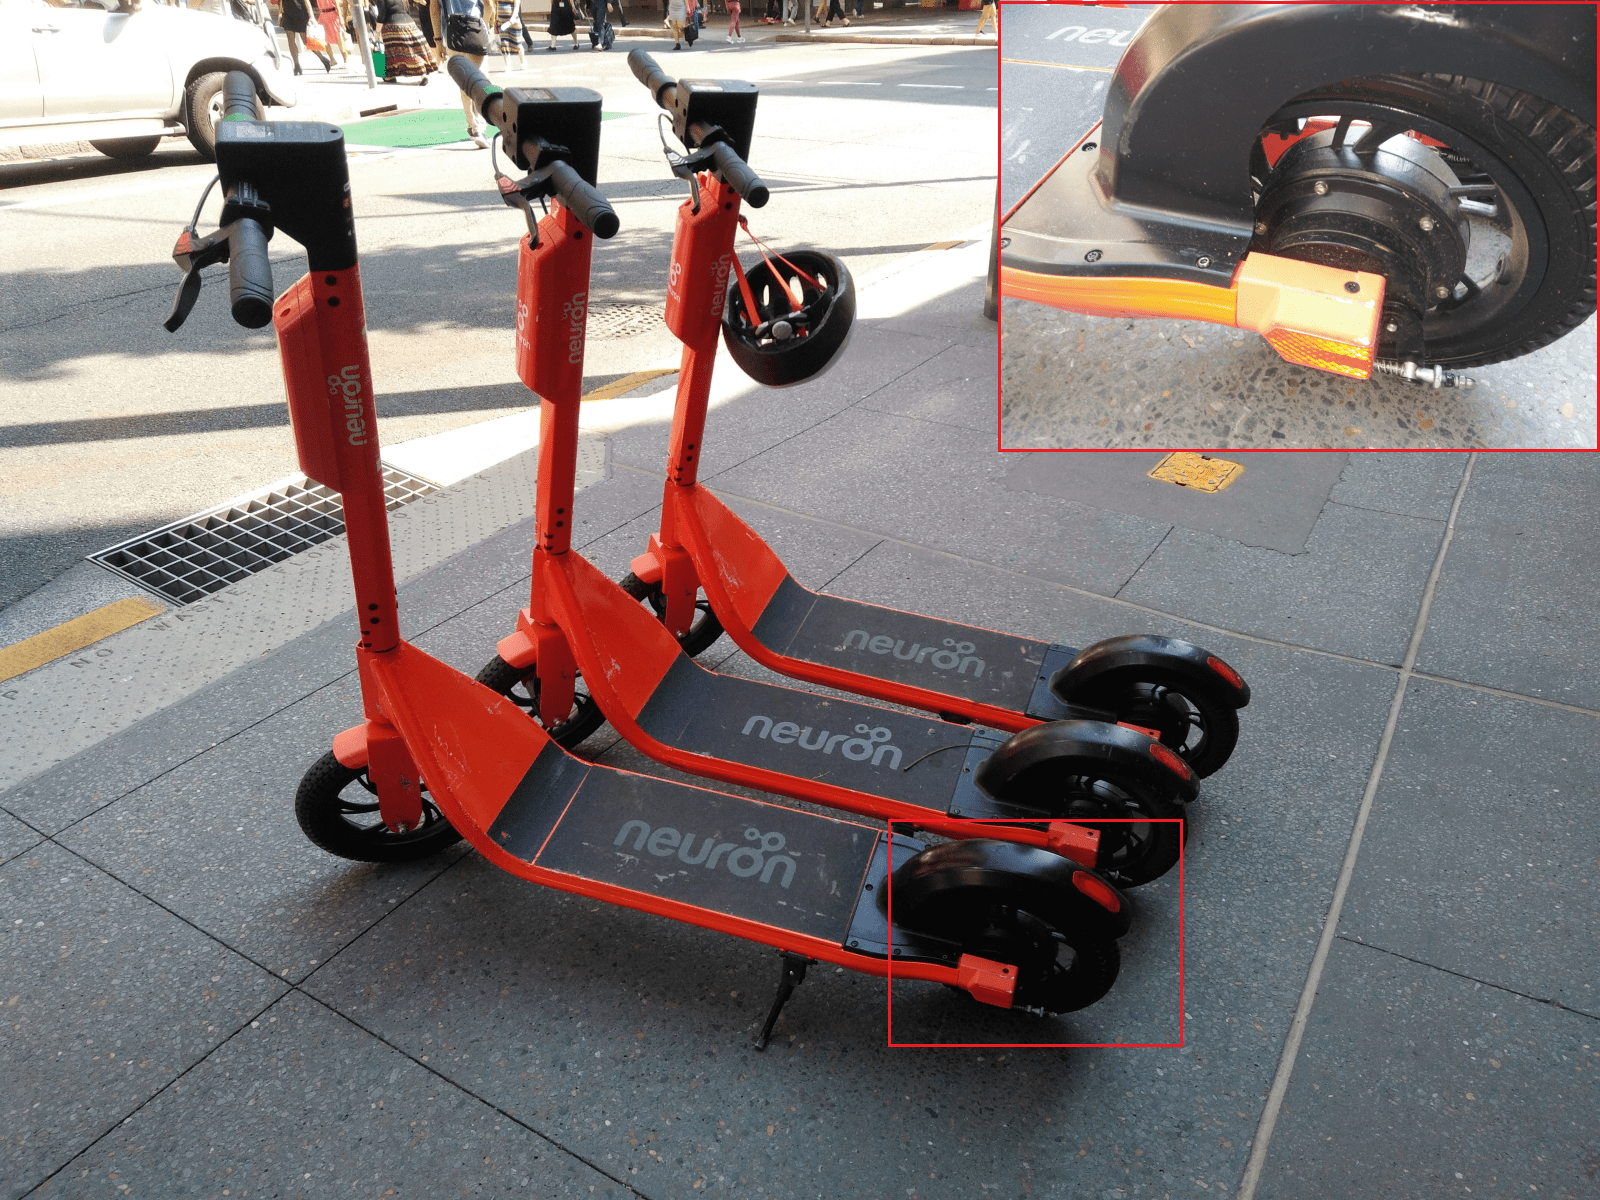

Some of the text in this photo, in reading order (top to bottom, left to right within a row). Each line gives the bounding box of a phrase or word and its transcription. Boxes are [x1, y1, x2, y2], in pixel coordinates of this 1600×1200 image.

[711, 253, 731, 316] neuron
[568, 292, 587, 364] neuron
[341, 365, 368, 446] neuron
[70, 647, 114, 670] NO
[147, 587, 247, 632] WASTE
[844, 629, 986, 678] neuron
[741, 715, 903, 770] neuron
[612, 819, 797, 889] neuron
